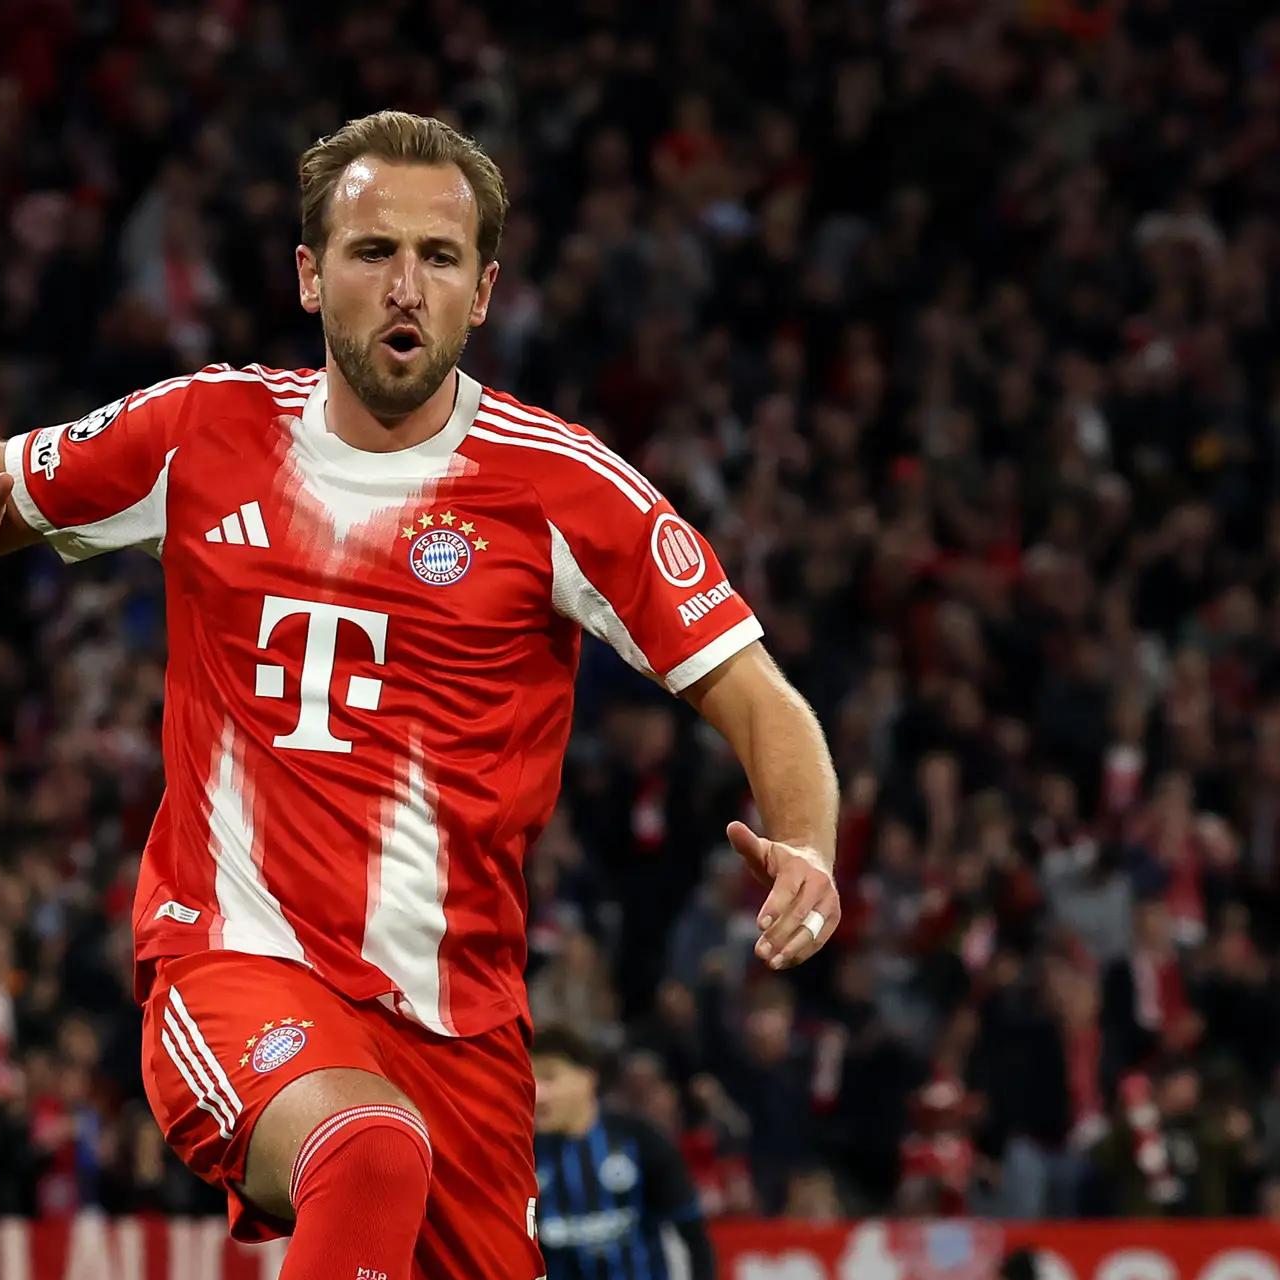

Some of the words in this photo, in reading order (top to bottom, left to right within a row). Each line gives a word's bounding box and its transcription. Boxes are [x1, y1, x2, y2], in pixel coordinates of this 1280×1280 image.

[417, 538, 431, 551] FC
[431, 533, 468, 558] BAYERN
[261, 1029, 300, 1046] BAYERN
[357, 1267, 387, 1280] MIA
